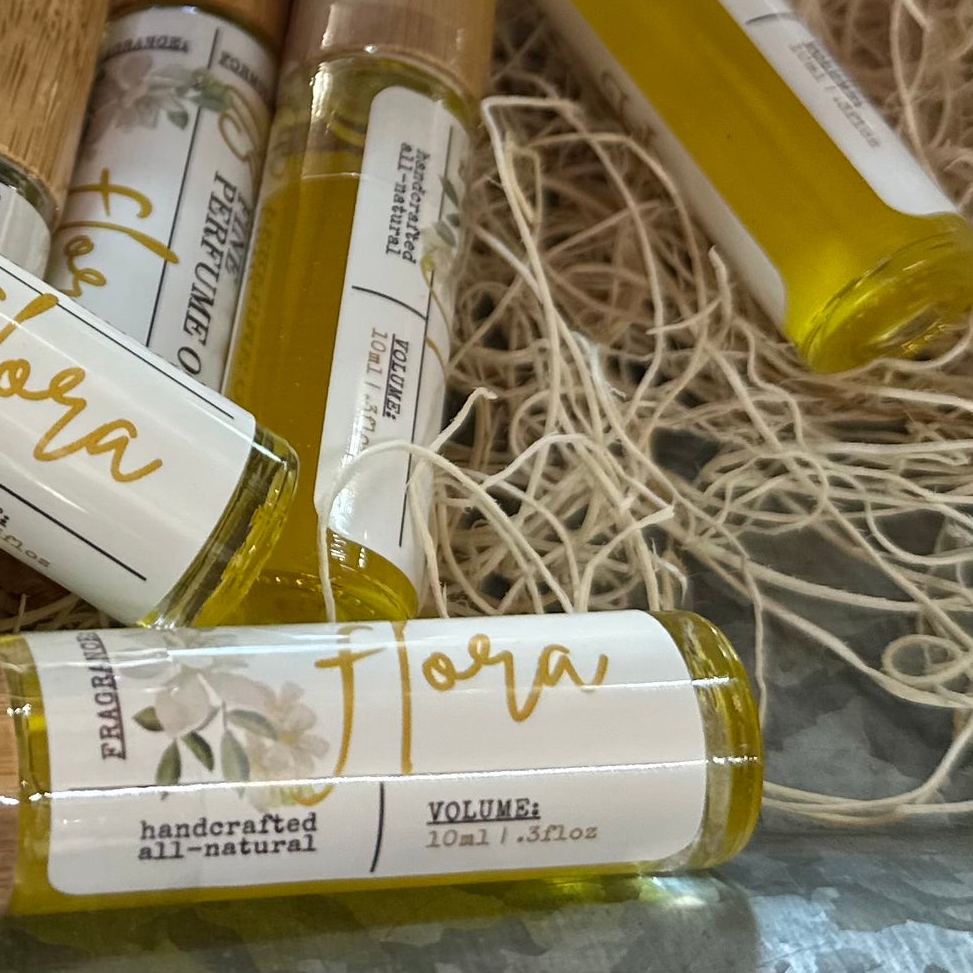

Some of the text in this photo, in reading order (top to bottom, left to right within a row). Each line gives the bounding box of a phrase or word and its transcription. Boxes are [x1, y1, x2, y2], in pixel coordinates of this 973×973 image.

[385, 141, 415, 256] all-natural
[183, 170, 237, 347] PERFUME
[366, 327, 388, 375] 10ml
[382, 333, 410, 420] VOLUME:
[292, 622, 609, 806] flora
[139, 812, 318, 840] handcrafted
[426, 797, 541, 825] VOLUME:
[137, 834, 317, 860] all-natural
[426, 828, 489, 848] 10ml
[516, 824, 599, 844] .3floz
